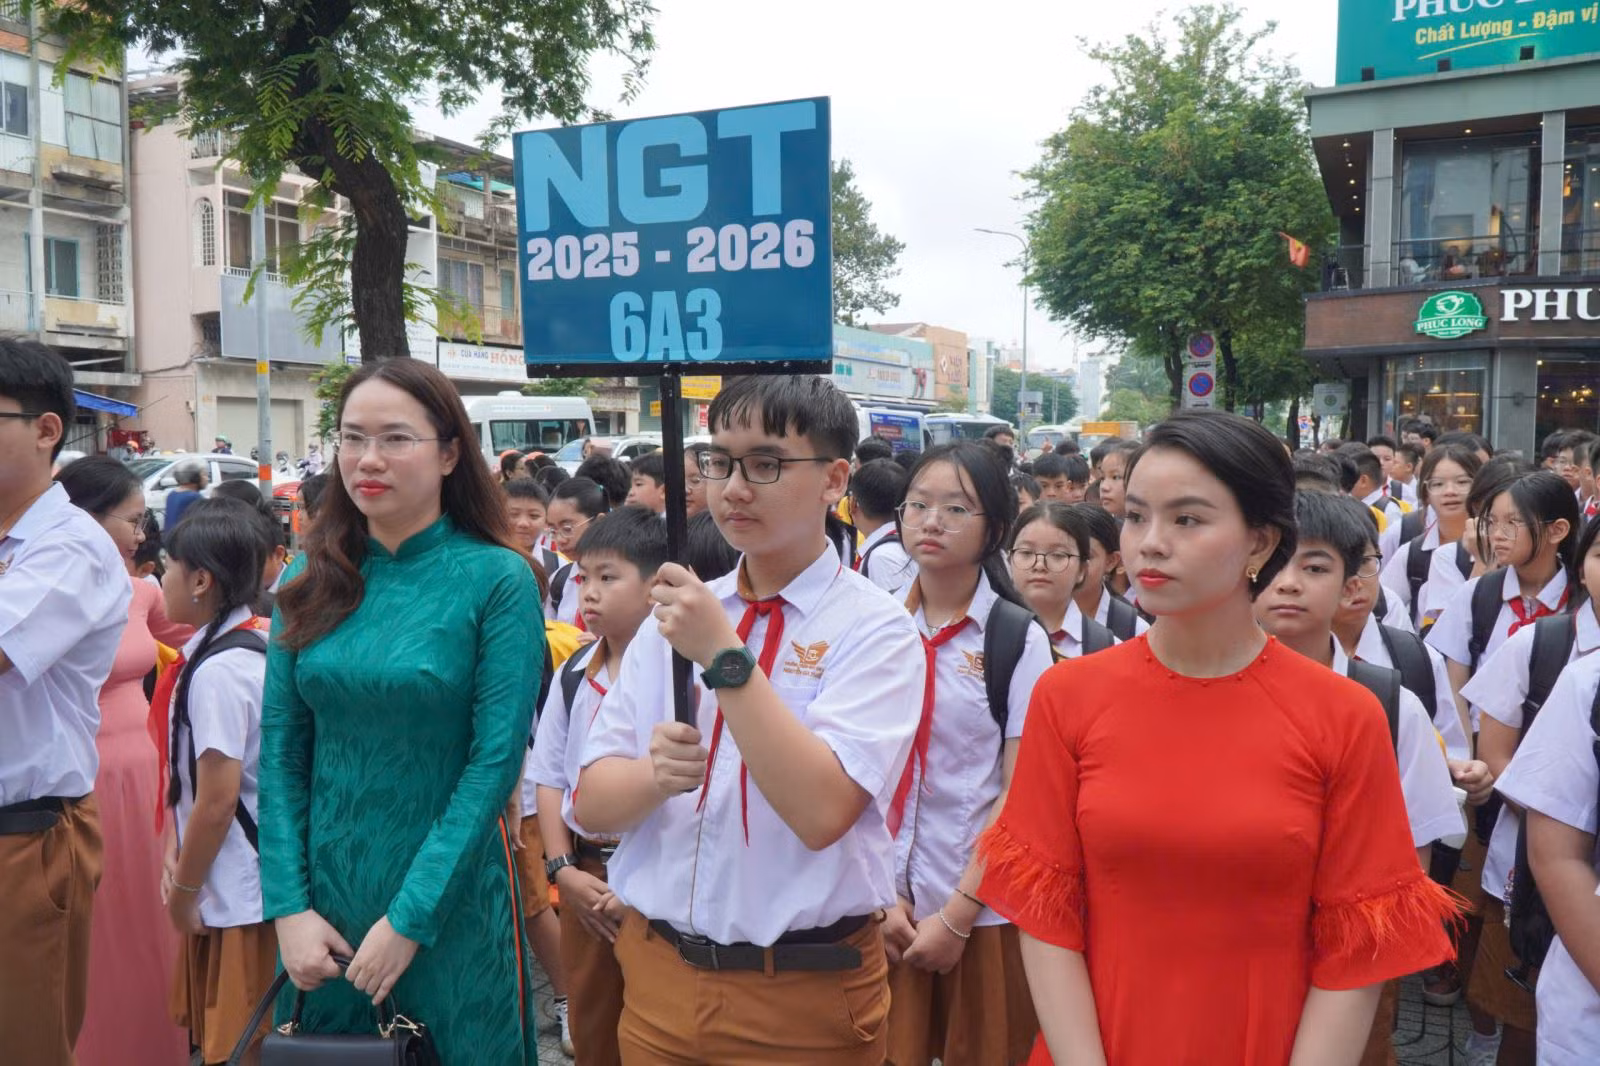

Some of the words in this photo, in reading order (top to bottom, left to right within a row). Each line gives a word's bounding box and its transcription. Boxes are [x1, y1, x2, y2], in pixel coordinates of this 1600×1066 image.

[1392, 0, 1503, 21] PHU
[1415, 22, 1455, 45] Chất
[1460, 19, 1513, 40] Lượng
[1532, 10, 1575, 30] Đậm
[521, 100, 816, 232] NGT
[527, 231, 640, 281] 2025
[655, 250, 671, 262] -
[687, 219, 815, 273] 2026
[609, 288, 723, 362] 6A3
[1417, 318, 1449, 331] PHUC
[1451, 318, 1483, 328] LONG
